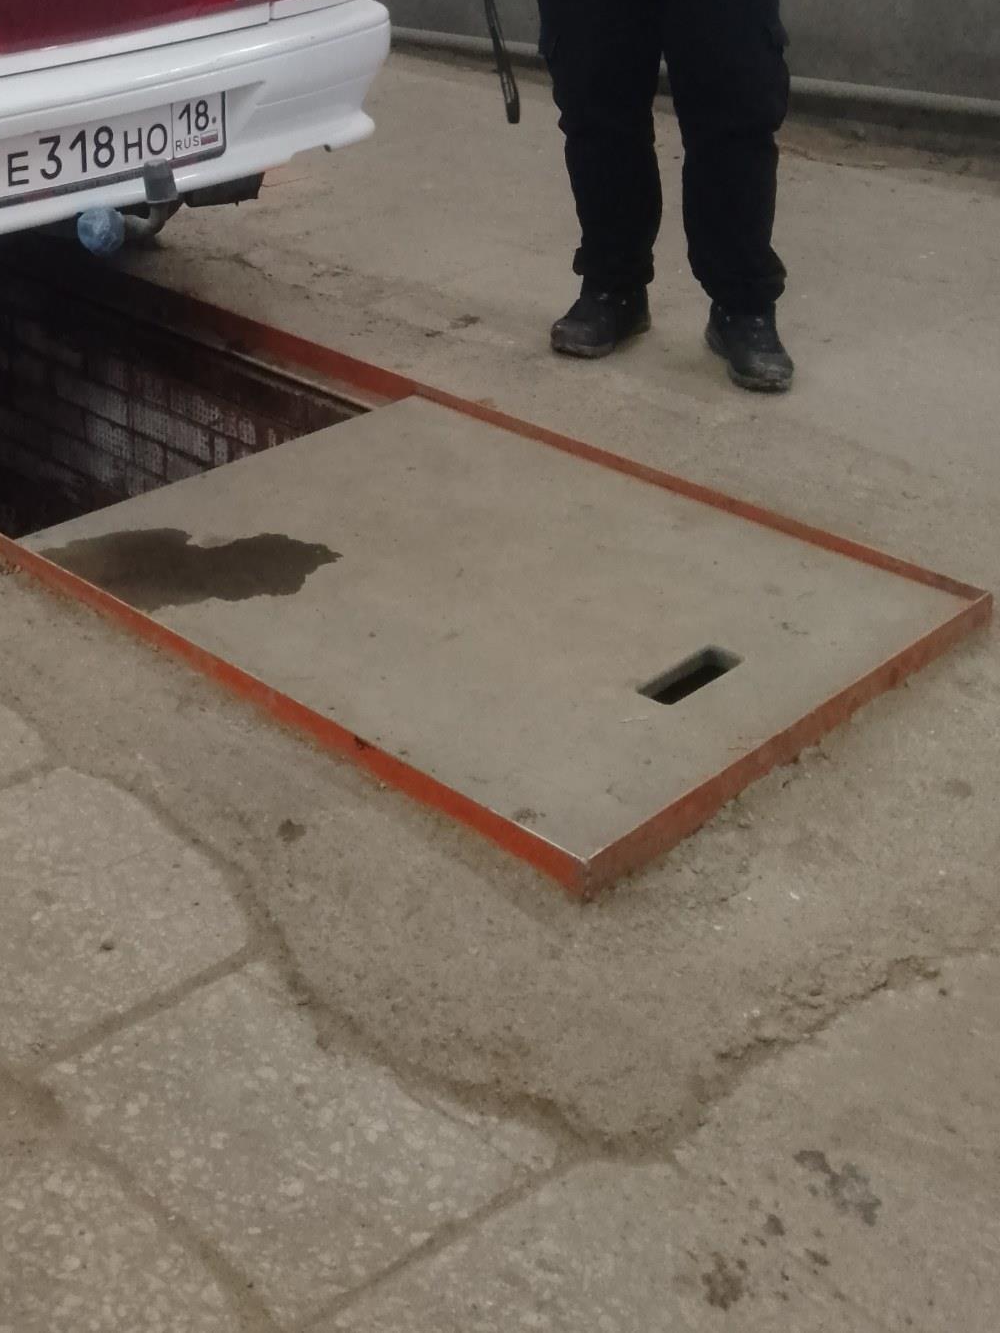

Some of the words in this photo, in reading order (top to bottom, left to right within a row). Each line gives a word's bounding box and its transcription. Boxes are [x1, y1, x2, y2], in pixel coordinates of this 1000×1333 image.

[178, 99, 209, 135] 18
[7, 123, 168, 187] Е318НО
[175, 136, 200, 152] RUS
